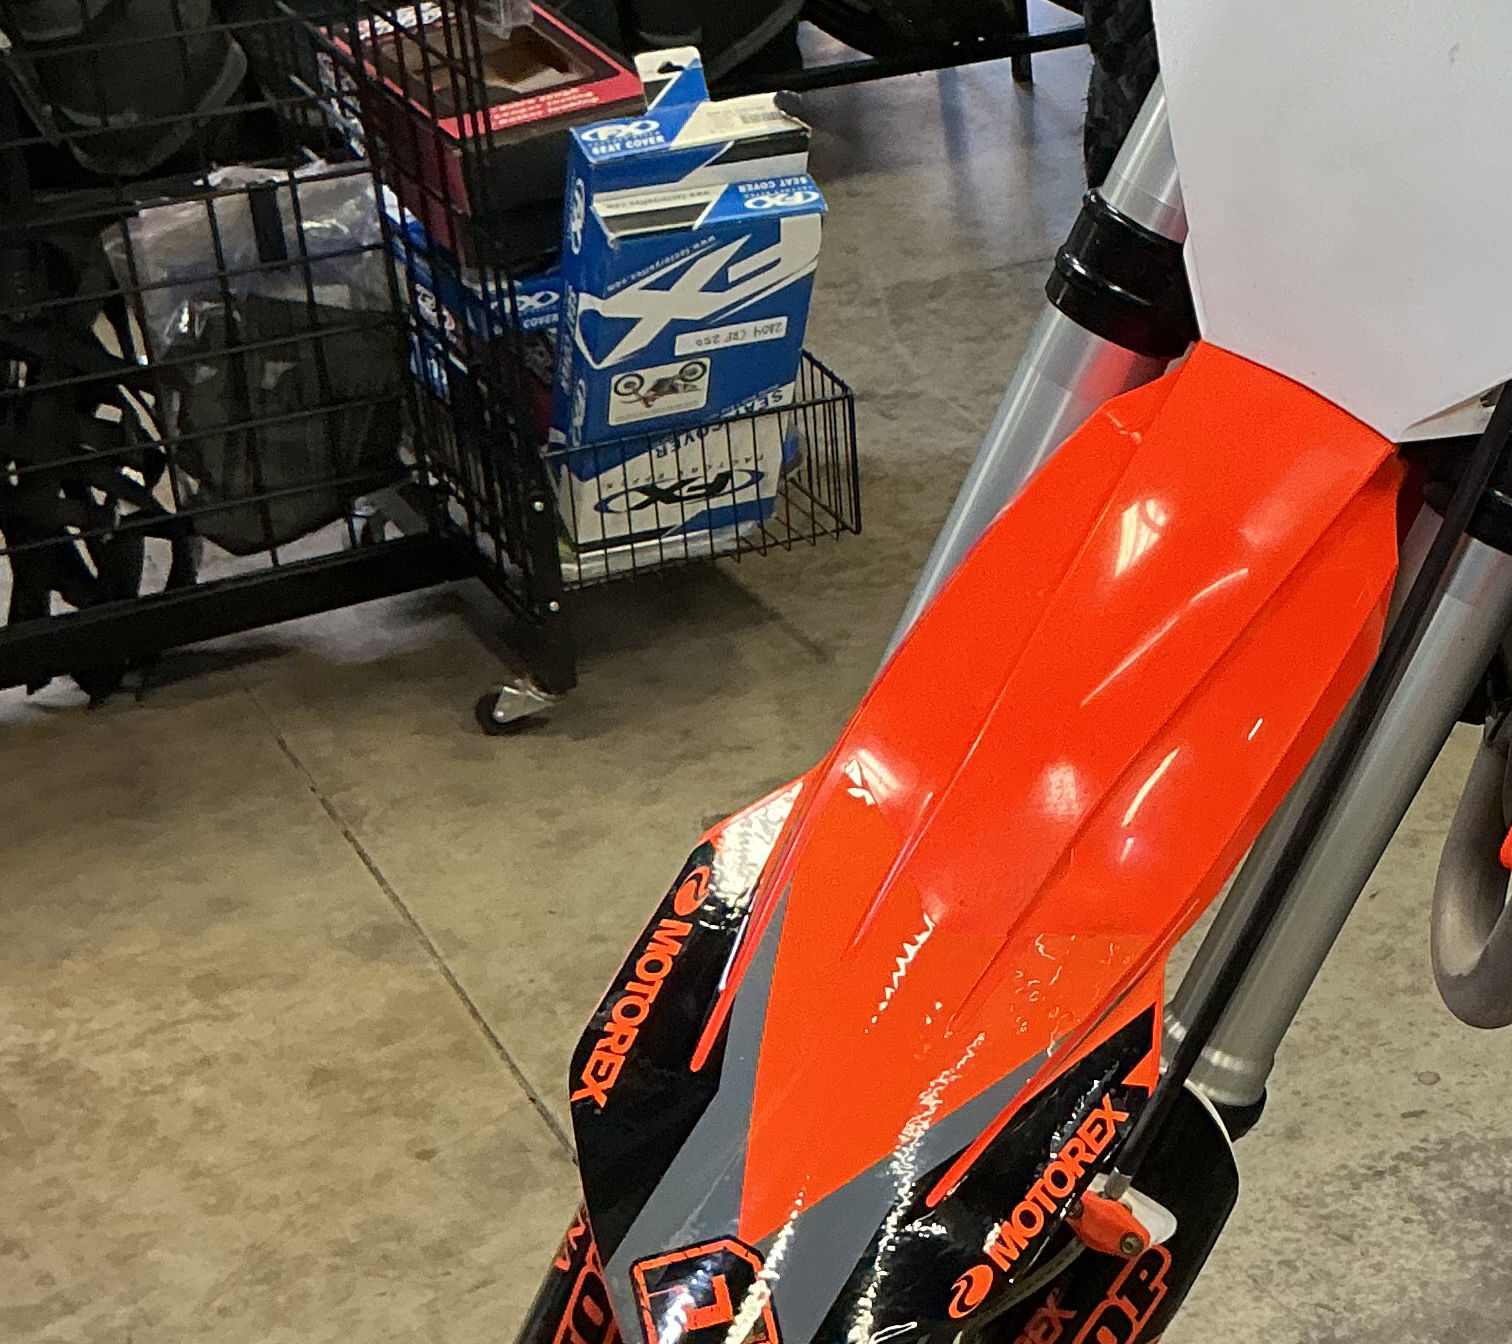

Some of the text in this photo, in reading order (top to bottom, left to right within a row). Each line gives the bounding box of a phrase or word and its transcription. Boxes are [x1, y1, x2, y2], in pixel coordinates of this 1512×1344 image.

[626, 135, 666, 150] COVER
[570, 918, 694, 1109] MOTOREX
[991, 1093, 1130, 1272] MOTOREX
